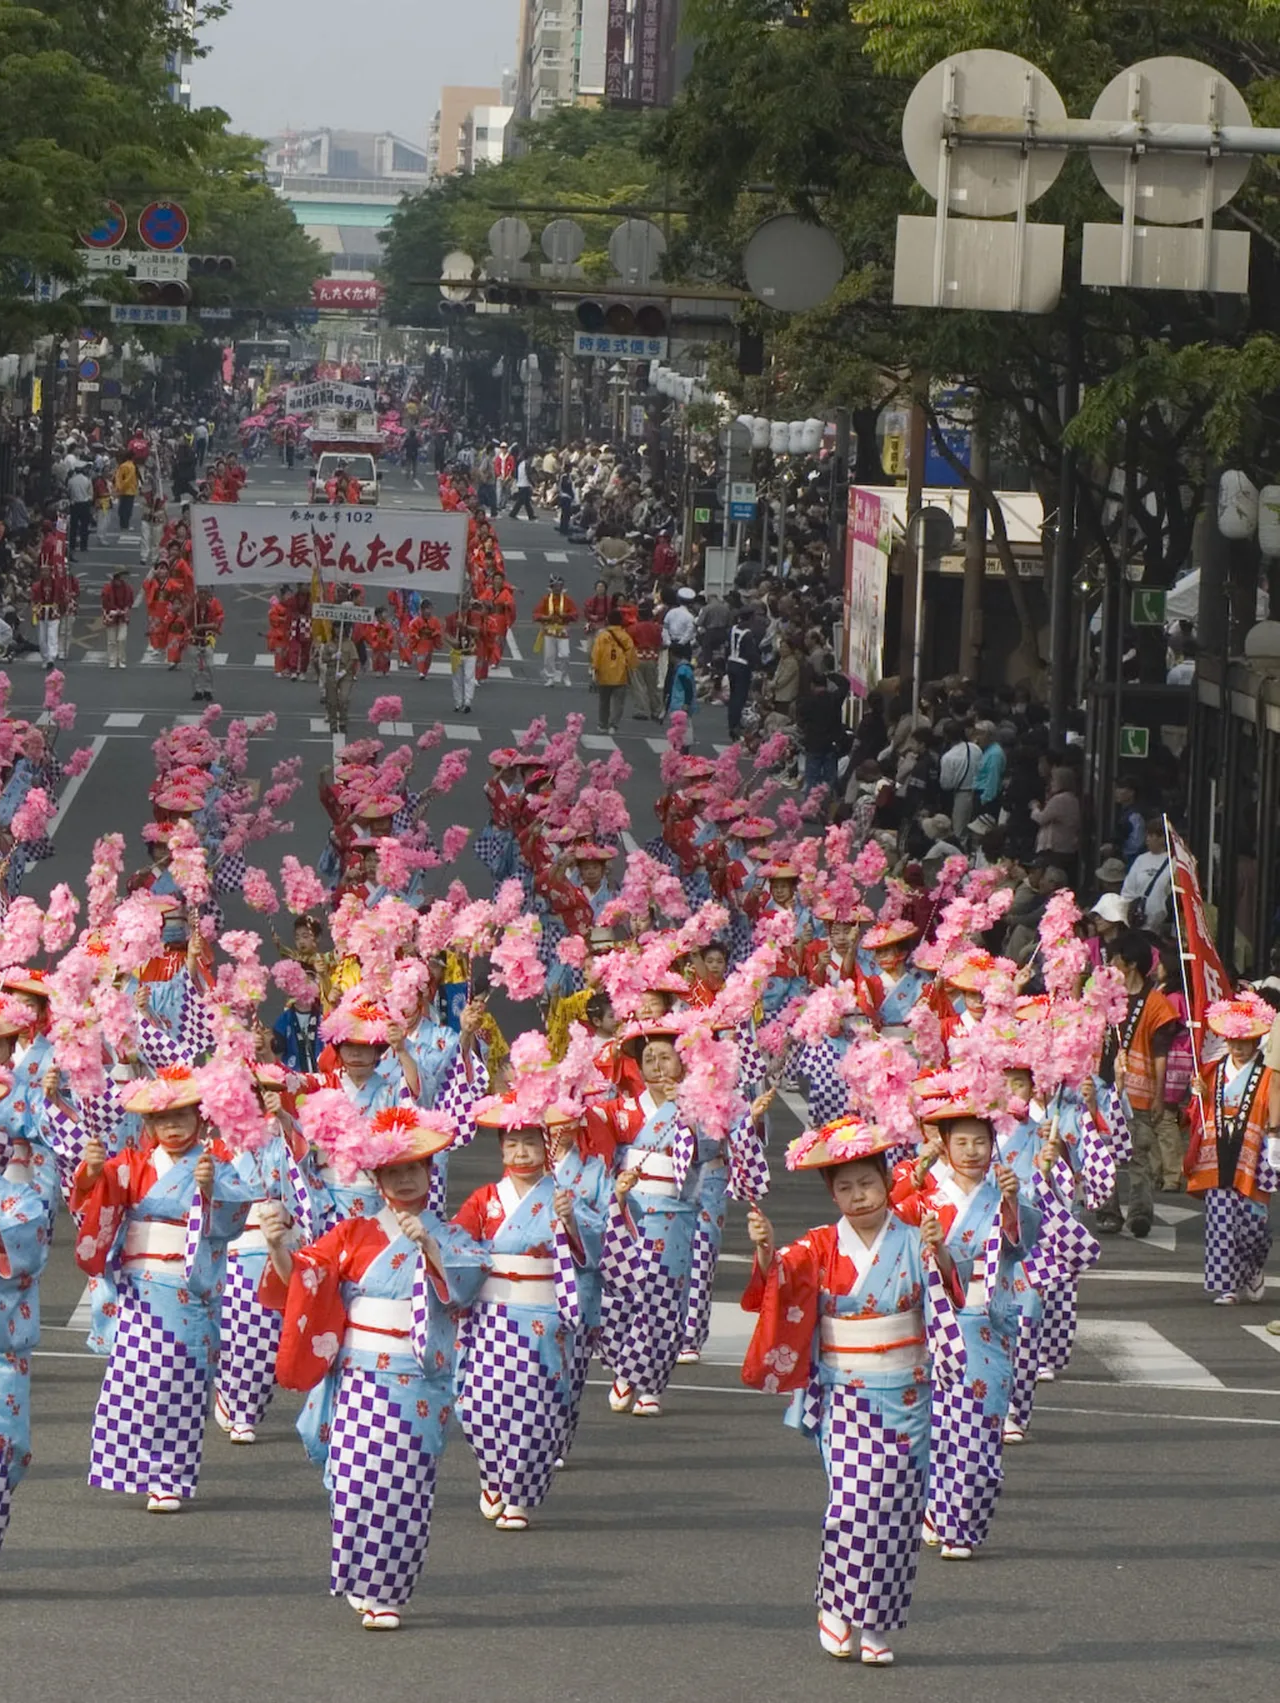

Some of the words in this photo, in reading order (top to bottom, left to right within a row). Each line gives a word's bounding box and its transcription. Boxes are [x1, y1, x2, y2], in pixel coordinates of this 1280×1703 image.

[579, 336, 661, 354] 時差式信号
[202, 516, 233, 575] コスモス
[236, 530, 452, 574] じろ長どんたく隊
